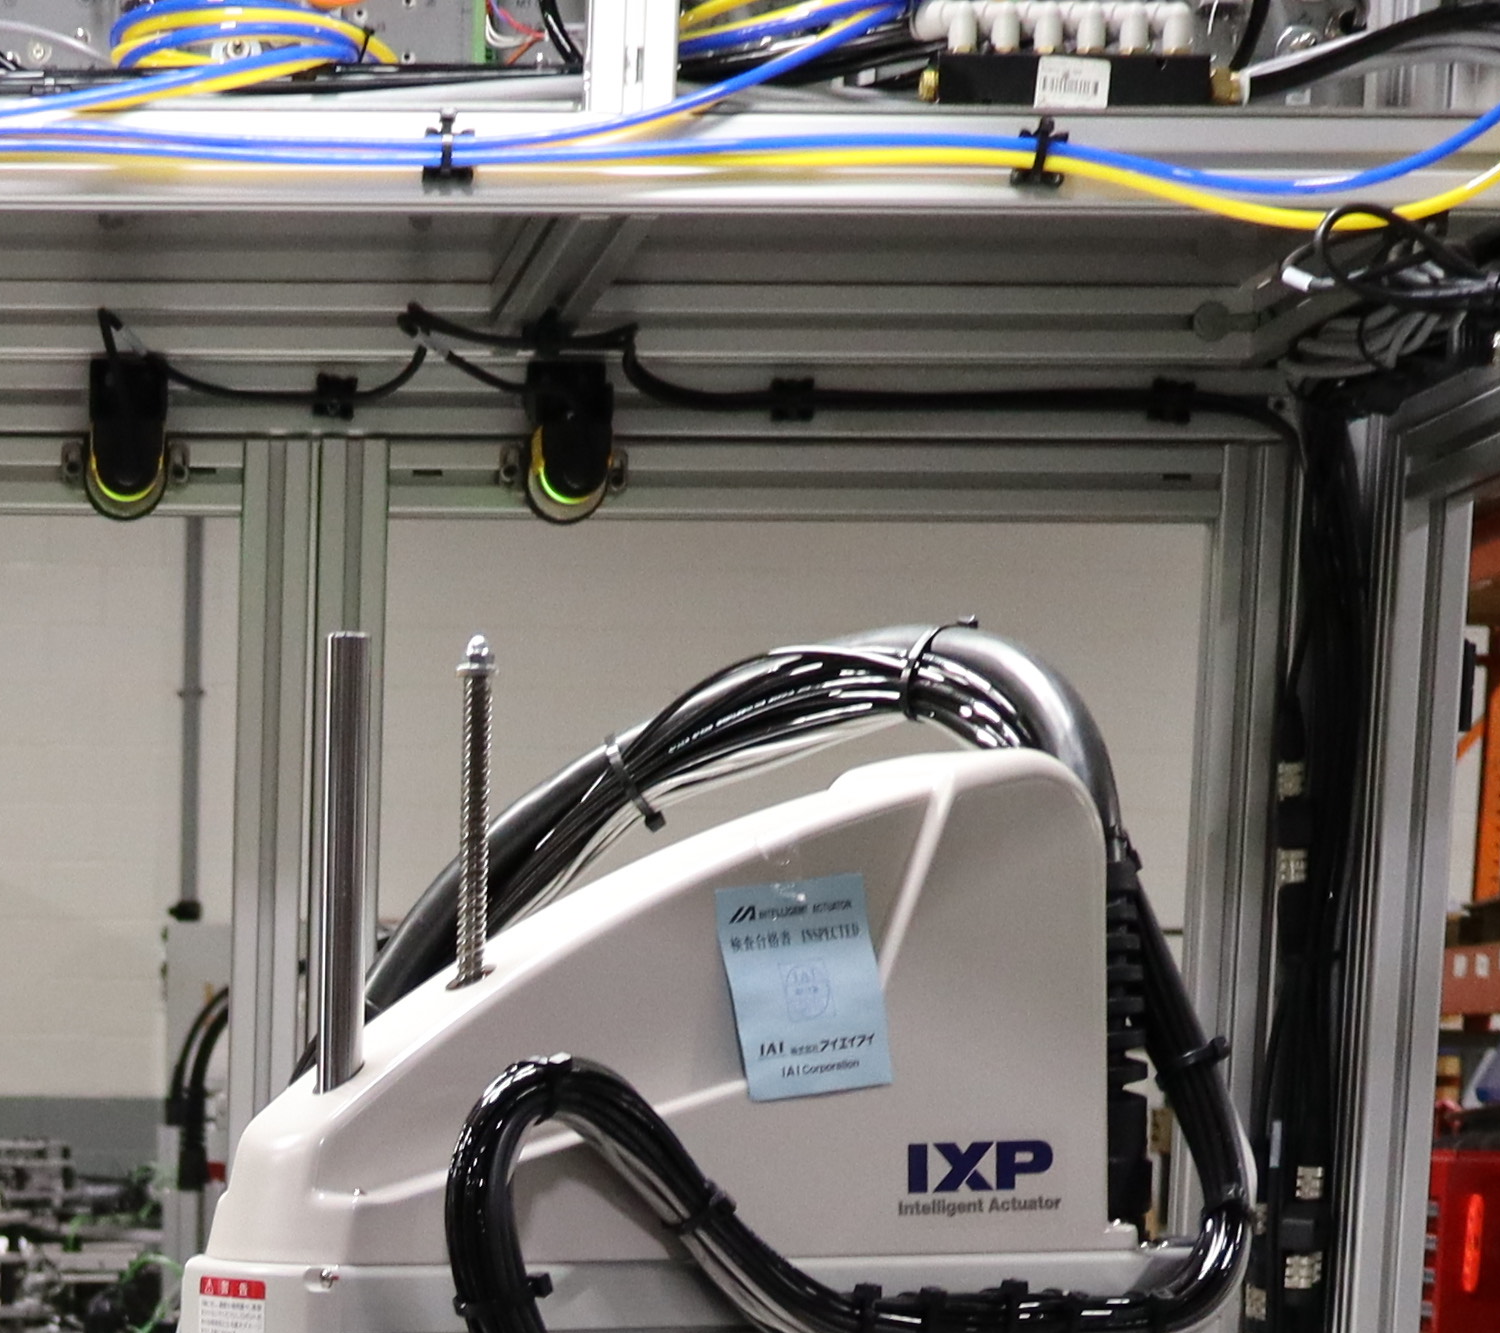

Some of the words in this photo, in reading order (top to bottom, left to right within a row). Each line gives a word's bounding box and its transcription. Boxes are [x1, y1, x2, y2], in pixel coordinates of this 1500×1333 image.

[801, 922, 860, 943] INSPECTED
[760, 1040, 785, 1057] IAI
[802, 1058, 860, 1077] Corporation
[908, 1140, 1053, 1194] IXP
[898, 1198, 985, 1217] Intelligent
[988, 1196, 1062, 1213] Actuator
